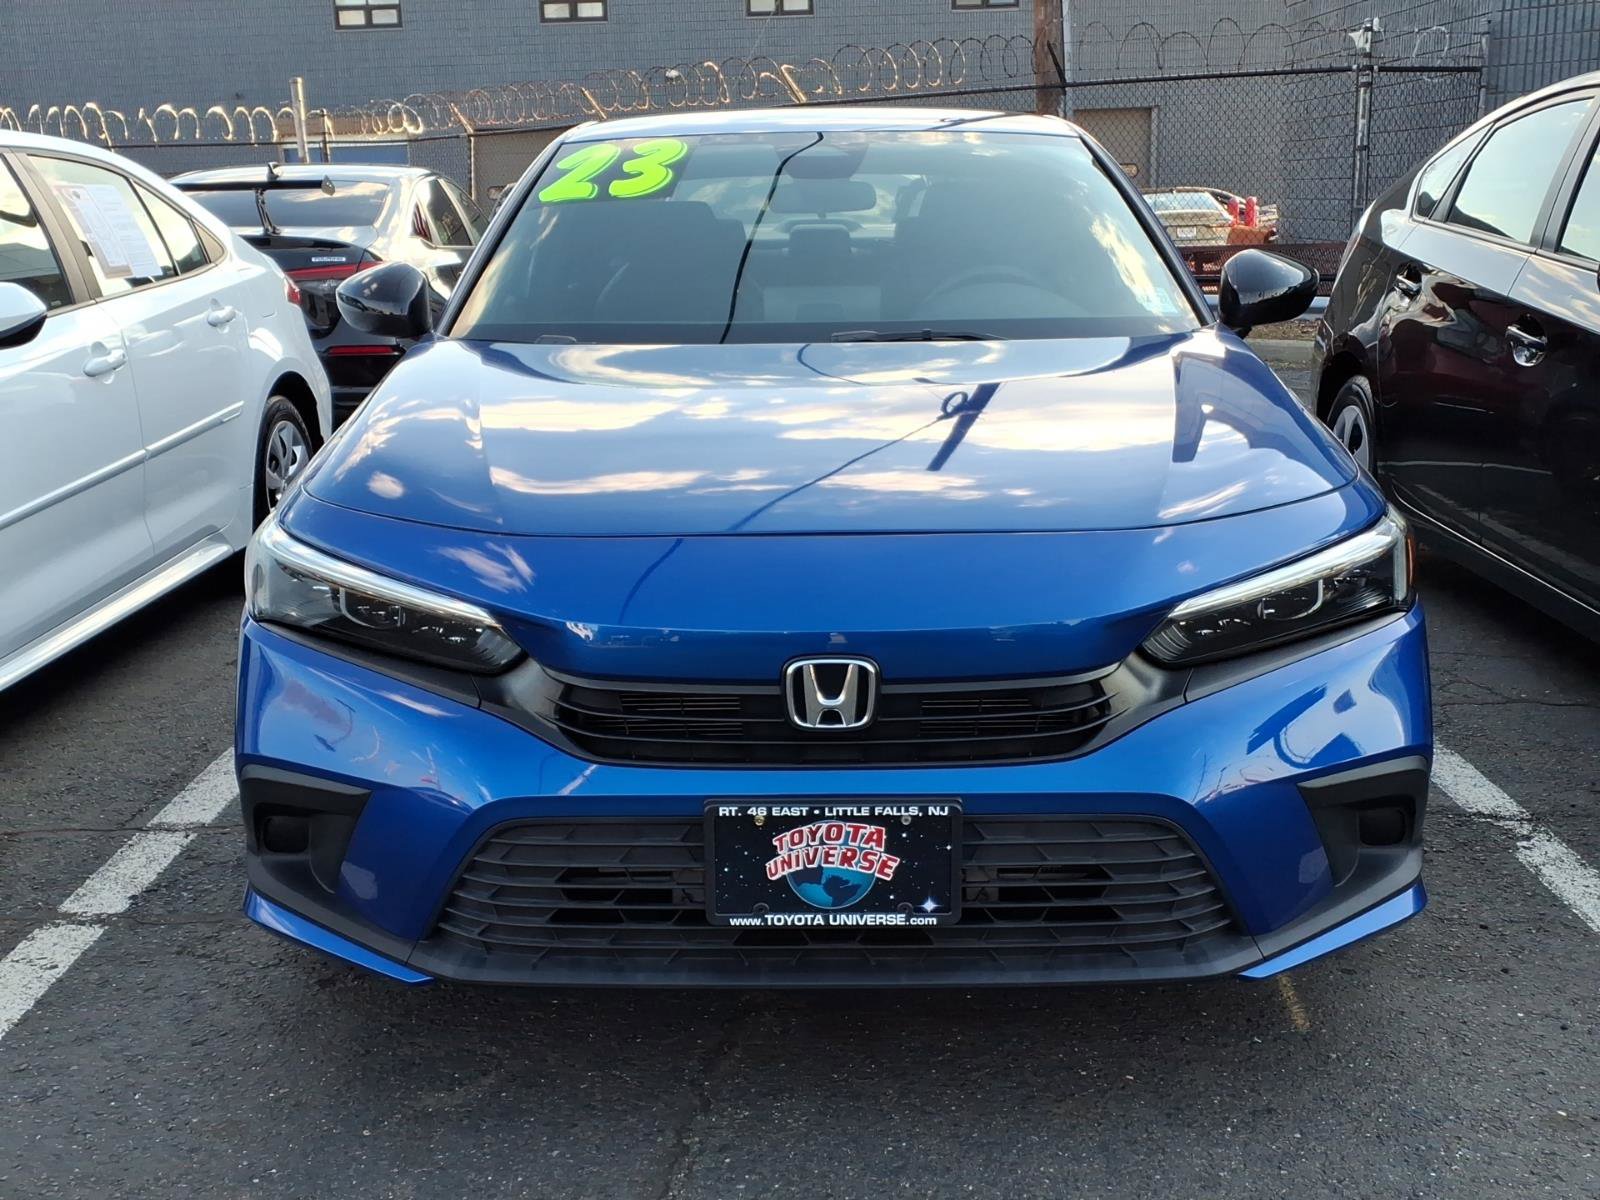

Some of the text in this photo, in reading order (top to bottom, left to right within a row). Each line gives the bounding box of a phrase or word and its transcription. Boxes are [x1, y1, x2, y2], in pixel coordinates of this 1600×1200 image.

[538, 138, 688, 202] 23
[718, 806, 949, 817] RT. 46 EAST LITTLE FALLS, NJ
[773, 823, 887, 853] TOYOTA
[765, 845, 900, 880] UNIVERSE
[729, 914, 937, 926] www.TOYOTA UNIVERSE.com
